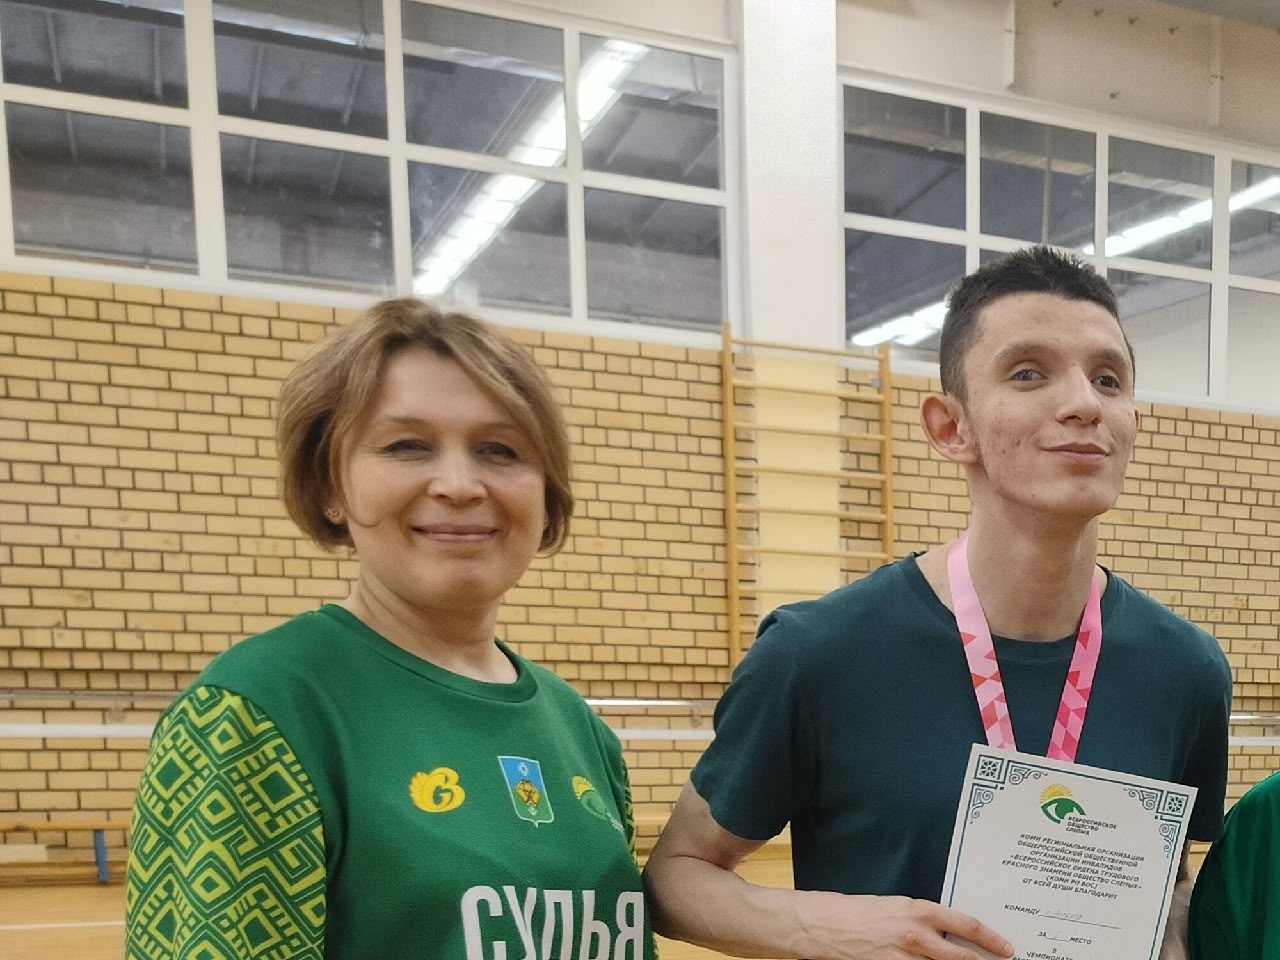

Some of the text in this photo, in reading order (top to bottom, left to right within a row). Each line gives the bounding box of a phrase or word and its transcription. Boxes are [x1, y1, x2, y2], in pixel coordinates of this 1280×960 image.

[1066, 821, 1099, 831] ОБЩЕСТВО
[1068, 816, 1117, 829] ВСЕРОССИЙСКОЕ
[1017, 840, 1139, 868] ОБЩЕРОССИЙСКОЙ ОБЩЕСТВЕННОЙ
[1042, 837, 1096, 852] РЕГИОНАЛЬНАЯ
[1096, 848, 1145, 861] ОРГАНИЗАЦИЯ
[1030, 850, 1123, 872] ОРГАНИЗАЦИИ ИНВАЛИДОВ
[1001, 859, 1038, 871] КРАСНОГО
[1039, 866, 1072, 877] ЗНАМЕНИ
[1073, 872, 1110, 884] ОБЩЕСТВО
[1072, 865, 1099, 875] ОРДЕНА
[1100, 870, 1140, 882] ТРУДОВОГО
[1033, 879, 1051, 888] ВСЕЙ
[1052, 882, 1074, 892] ДУШИ
[1074, 886, 1118, 899] БЛАГОДАРИТ
[1046, 875, 1070, 884] (КОМИ
[1081, 881, 1098, 890] ВОС)
[1004, 904, 1041, 915] КОМАНДУ
[1069, 937, 1092, 945] МЕСТО
